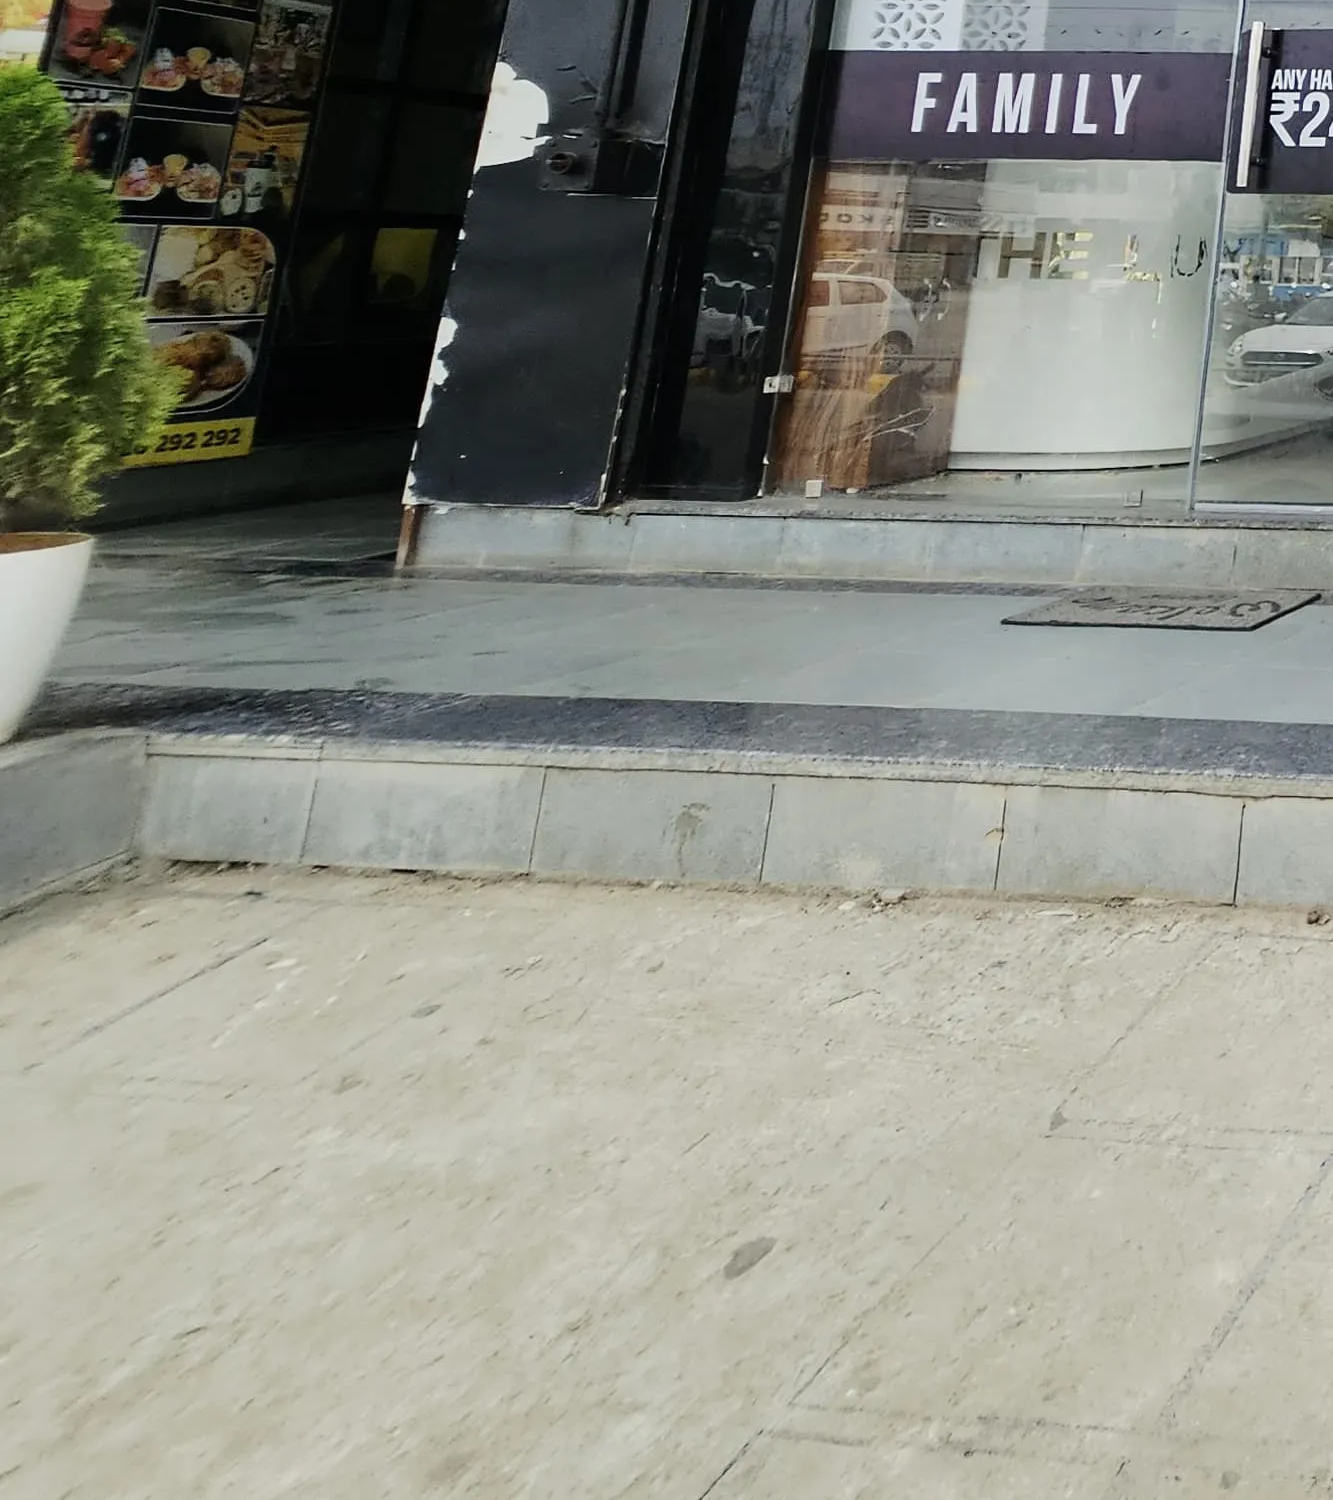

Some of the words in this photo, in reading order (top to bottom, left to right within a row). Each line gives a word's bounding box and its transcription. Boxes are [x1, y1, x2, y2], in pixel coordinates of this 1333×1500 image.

[1271, 69, 1307, 90] ANY
[910, 72, 1142, 135] FAMILY
[154, 432, 199, 453] 292
[200, 427, 241, 449] 292
